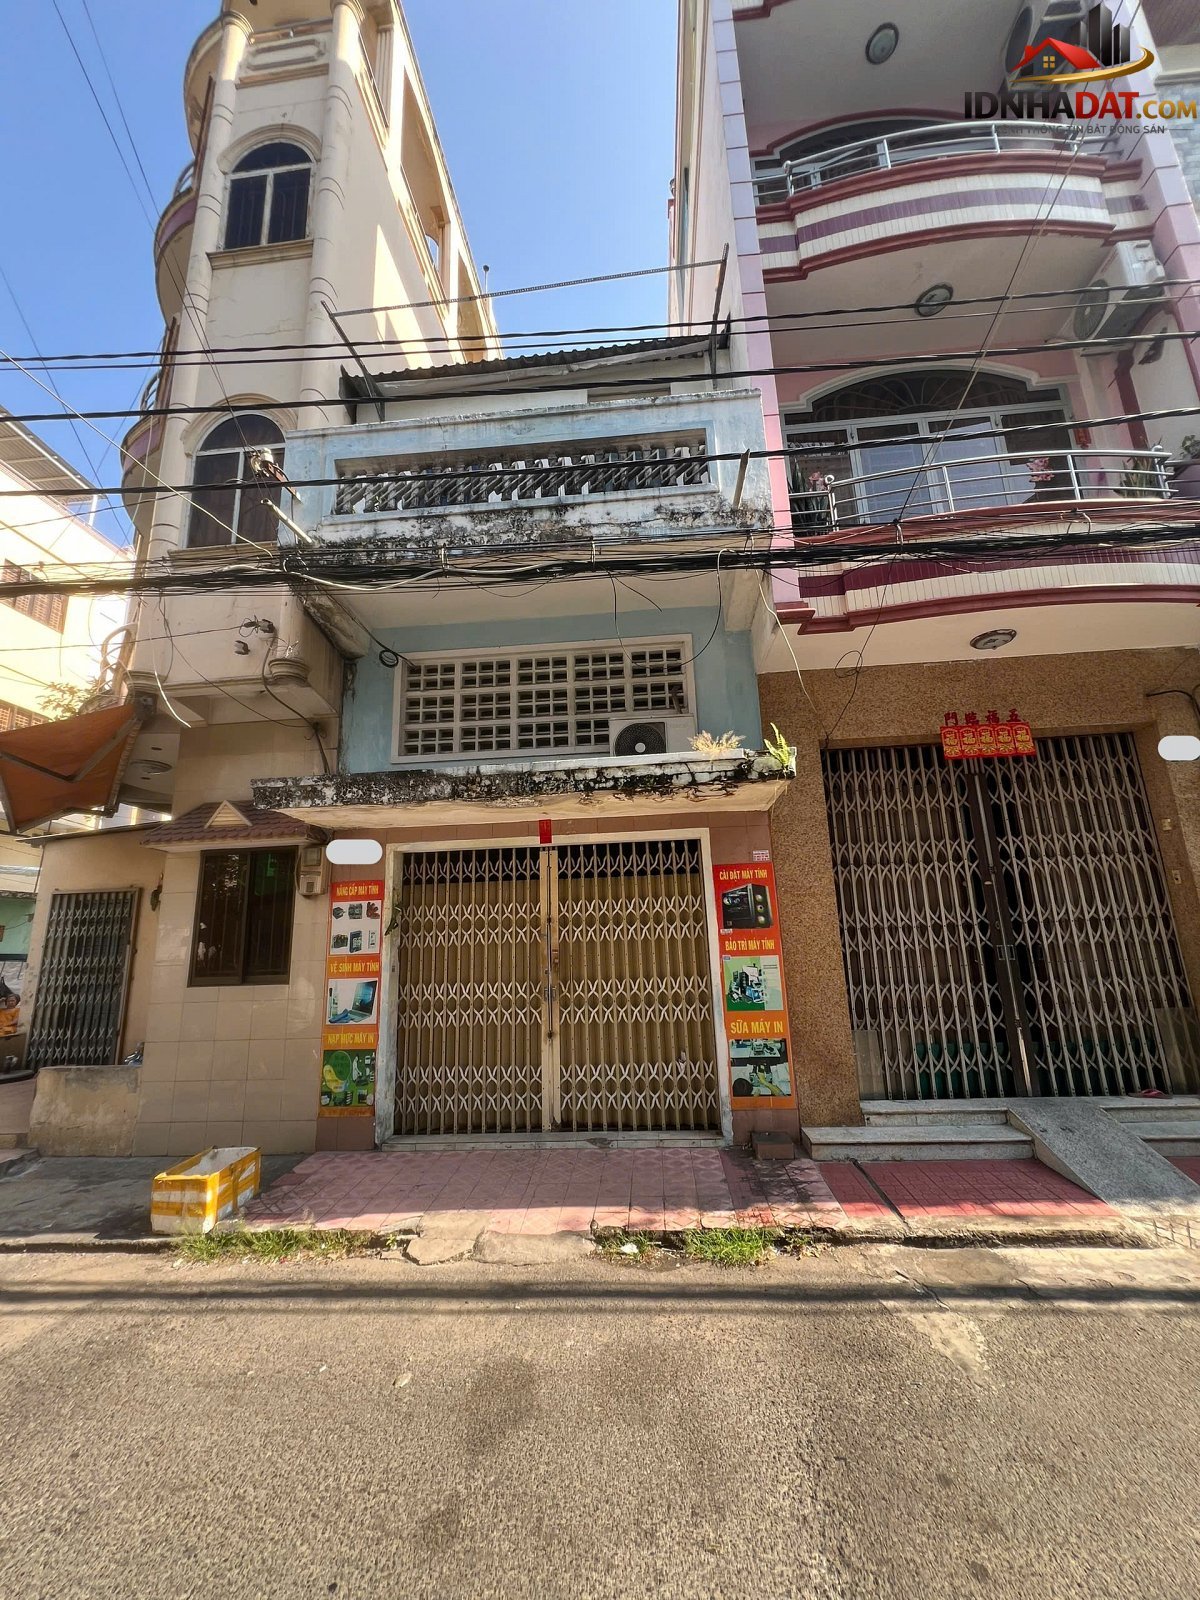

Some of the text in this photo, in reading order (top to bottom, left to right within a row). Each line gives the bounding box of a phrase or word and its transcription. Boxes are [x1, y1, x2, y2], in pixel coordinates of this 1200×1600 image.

[741, 868, 754, 879] MÁY
[754, 867, 768, 879] TÍNH
[748, 937, 761, 951] MÁY
[760, 936, 775, 950] TÍNH
[338, 962, 352, 973] SINH
[366, 959, 380, 972] TÍNH
[750, 1018, 771, 1034] MÁY
[773, 1020, 784, 1033] IN
